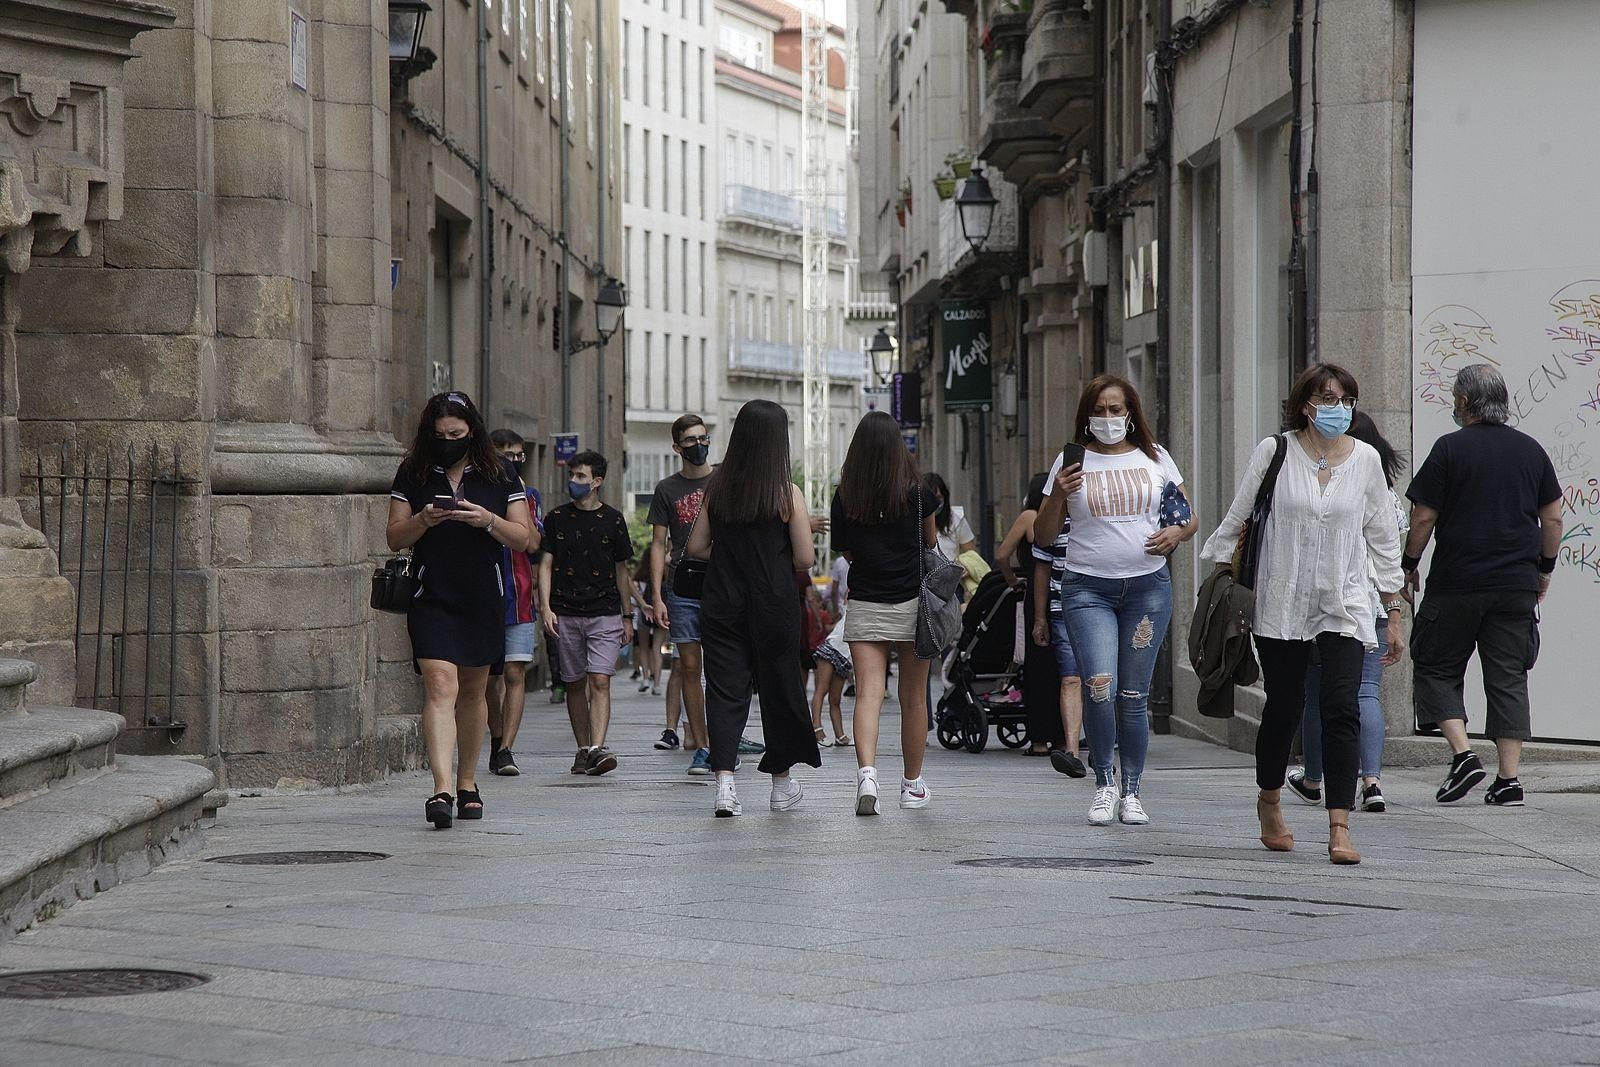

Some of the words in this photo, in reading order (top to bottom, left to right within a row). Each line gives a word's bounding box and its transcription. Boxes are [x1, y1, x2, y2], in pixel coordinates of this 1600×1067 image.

[944, 310, 985, 321] CALZADOS
[945, 332, 991, 389] Marfil
[1086, 467, 1152, 517] REALLY?
